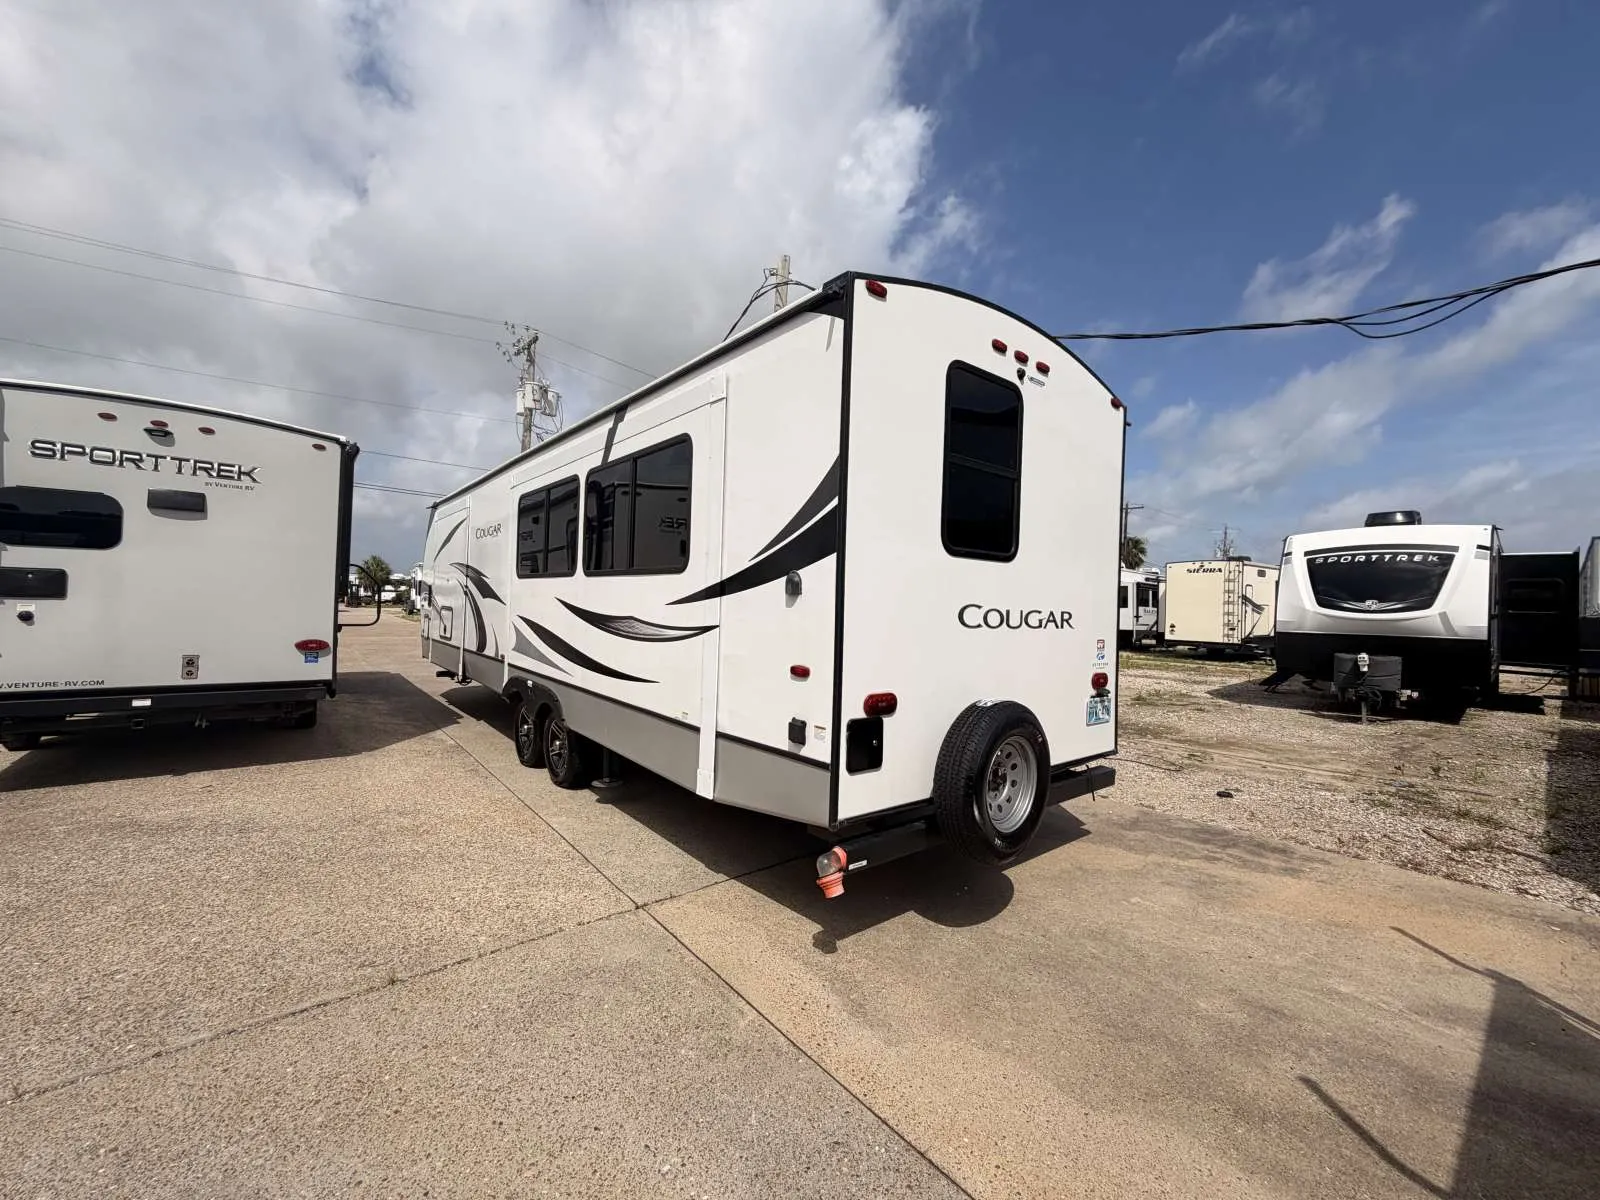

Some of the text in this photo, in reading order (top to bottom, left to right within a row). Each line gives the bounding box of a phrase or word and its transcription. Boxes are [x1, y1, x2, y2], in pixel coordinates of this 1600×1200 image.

[29, 438, 262, 484] SPORTTREK
[475, 522, 502, 540] COUGAR
[1315, 554, 1440, 564] SPORTTREK
[1186, 567, 1224, 575] SIERRA
[957, 603, 1076, 630] COUGAR
